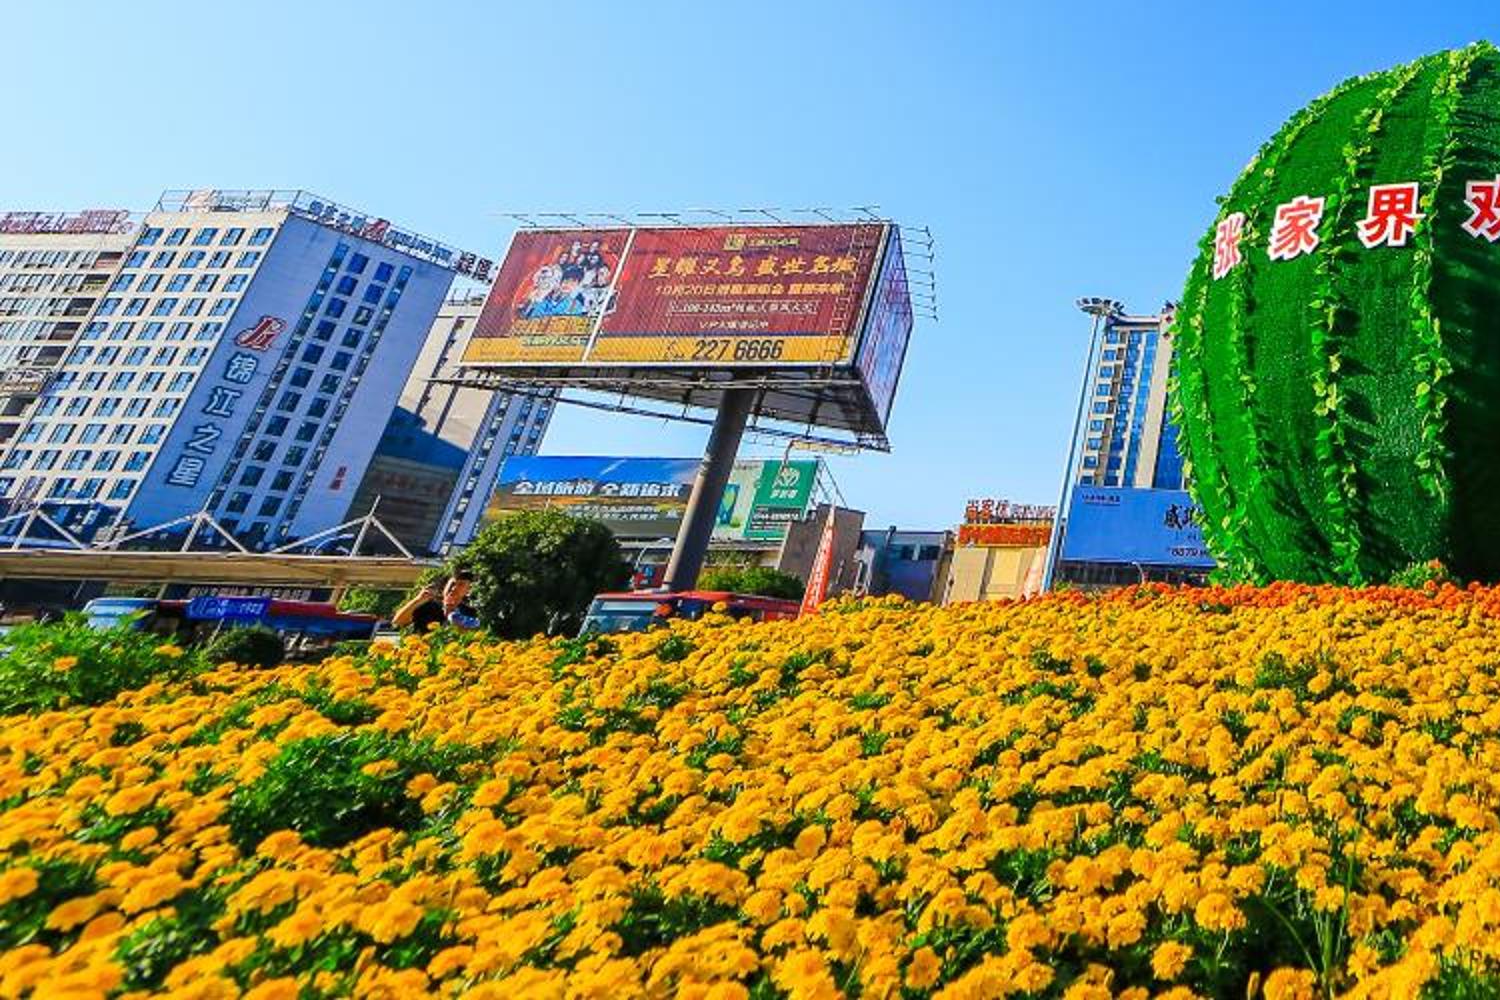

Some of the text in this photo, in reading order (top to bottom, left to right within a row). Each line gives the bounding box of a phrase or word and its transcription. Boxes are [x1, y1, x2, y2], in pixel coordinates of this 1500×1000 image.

[692, 340, 785, 360] 227 6666
[166, 351, 260, 488] 锦江之星
